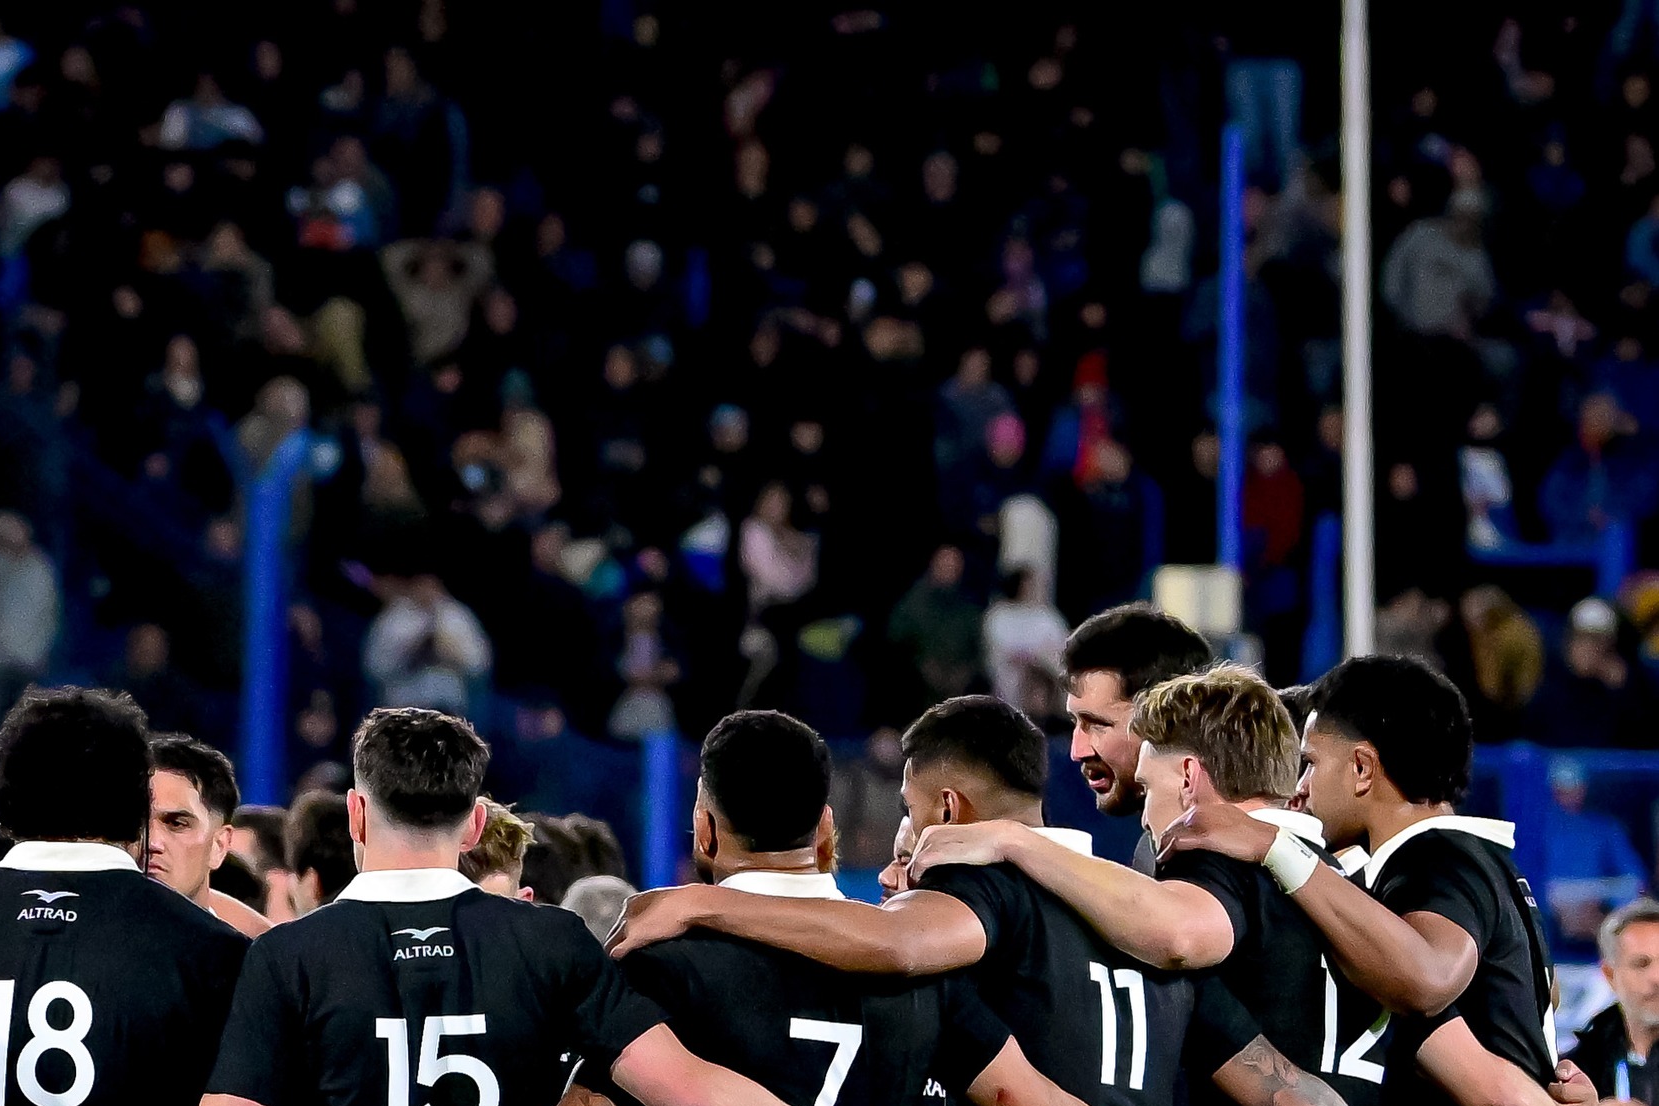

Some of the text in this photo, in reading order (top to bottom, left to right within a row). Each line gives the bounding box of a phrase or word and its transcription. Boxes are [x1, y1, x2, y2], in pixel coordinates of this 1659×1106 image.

[16, 907, 78, 922] ALTRAD
[393, 945, 455, 961] ALTRAD
[1089, 960, 1148, 1091] 11
